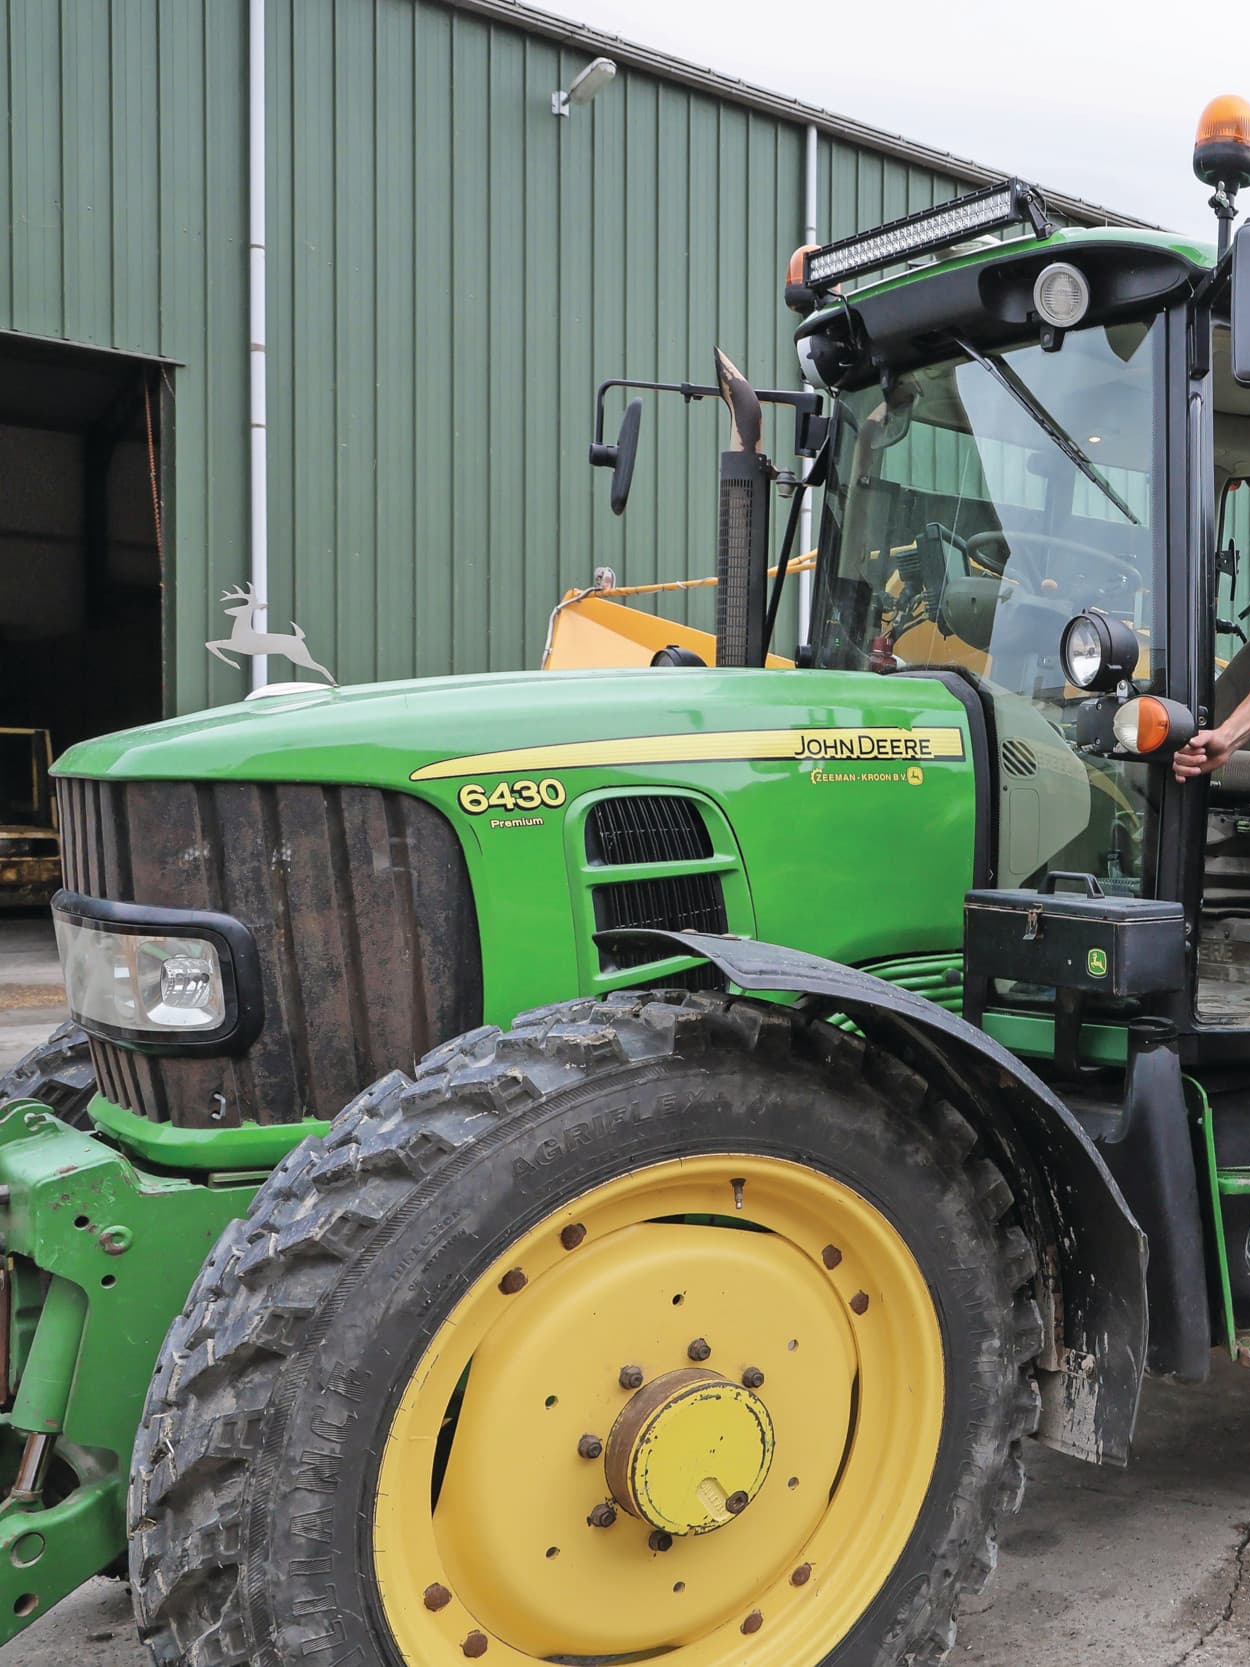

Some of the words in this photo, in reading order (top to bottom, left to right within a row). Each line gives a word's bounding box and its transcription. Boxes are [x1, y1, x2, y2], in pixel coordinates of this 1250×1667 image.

[795, 735, 853, 756] JOHN
[858, 735, 932, 756] DEERE
[815, 773, 856, 782] ZEEMAN
[861, 773, 891, 782] KROON
[458, 778, 567, 816] 6430
[490, 816, 544, 829] Premium
